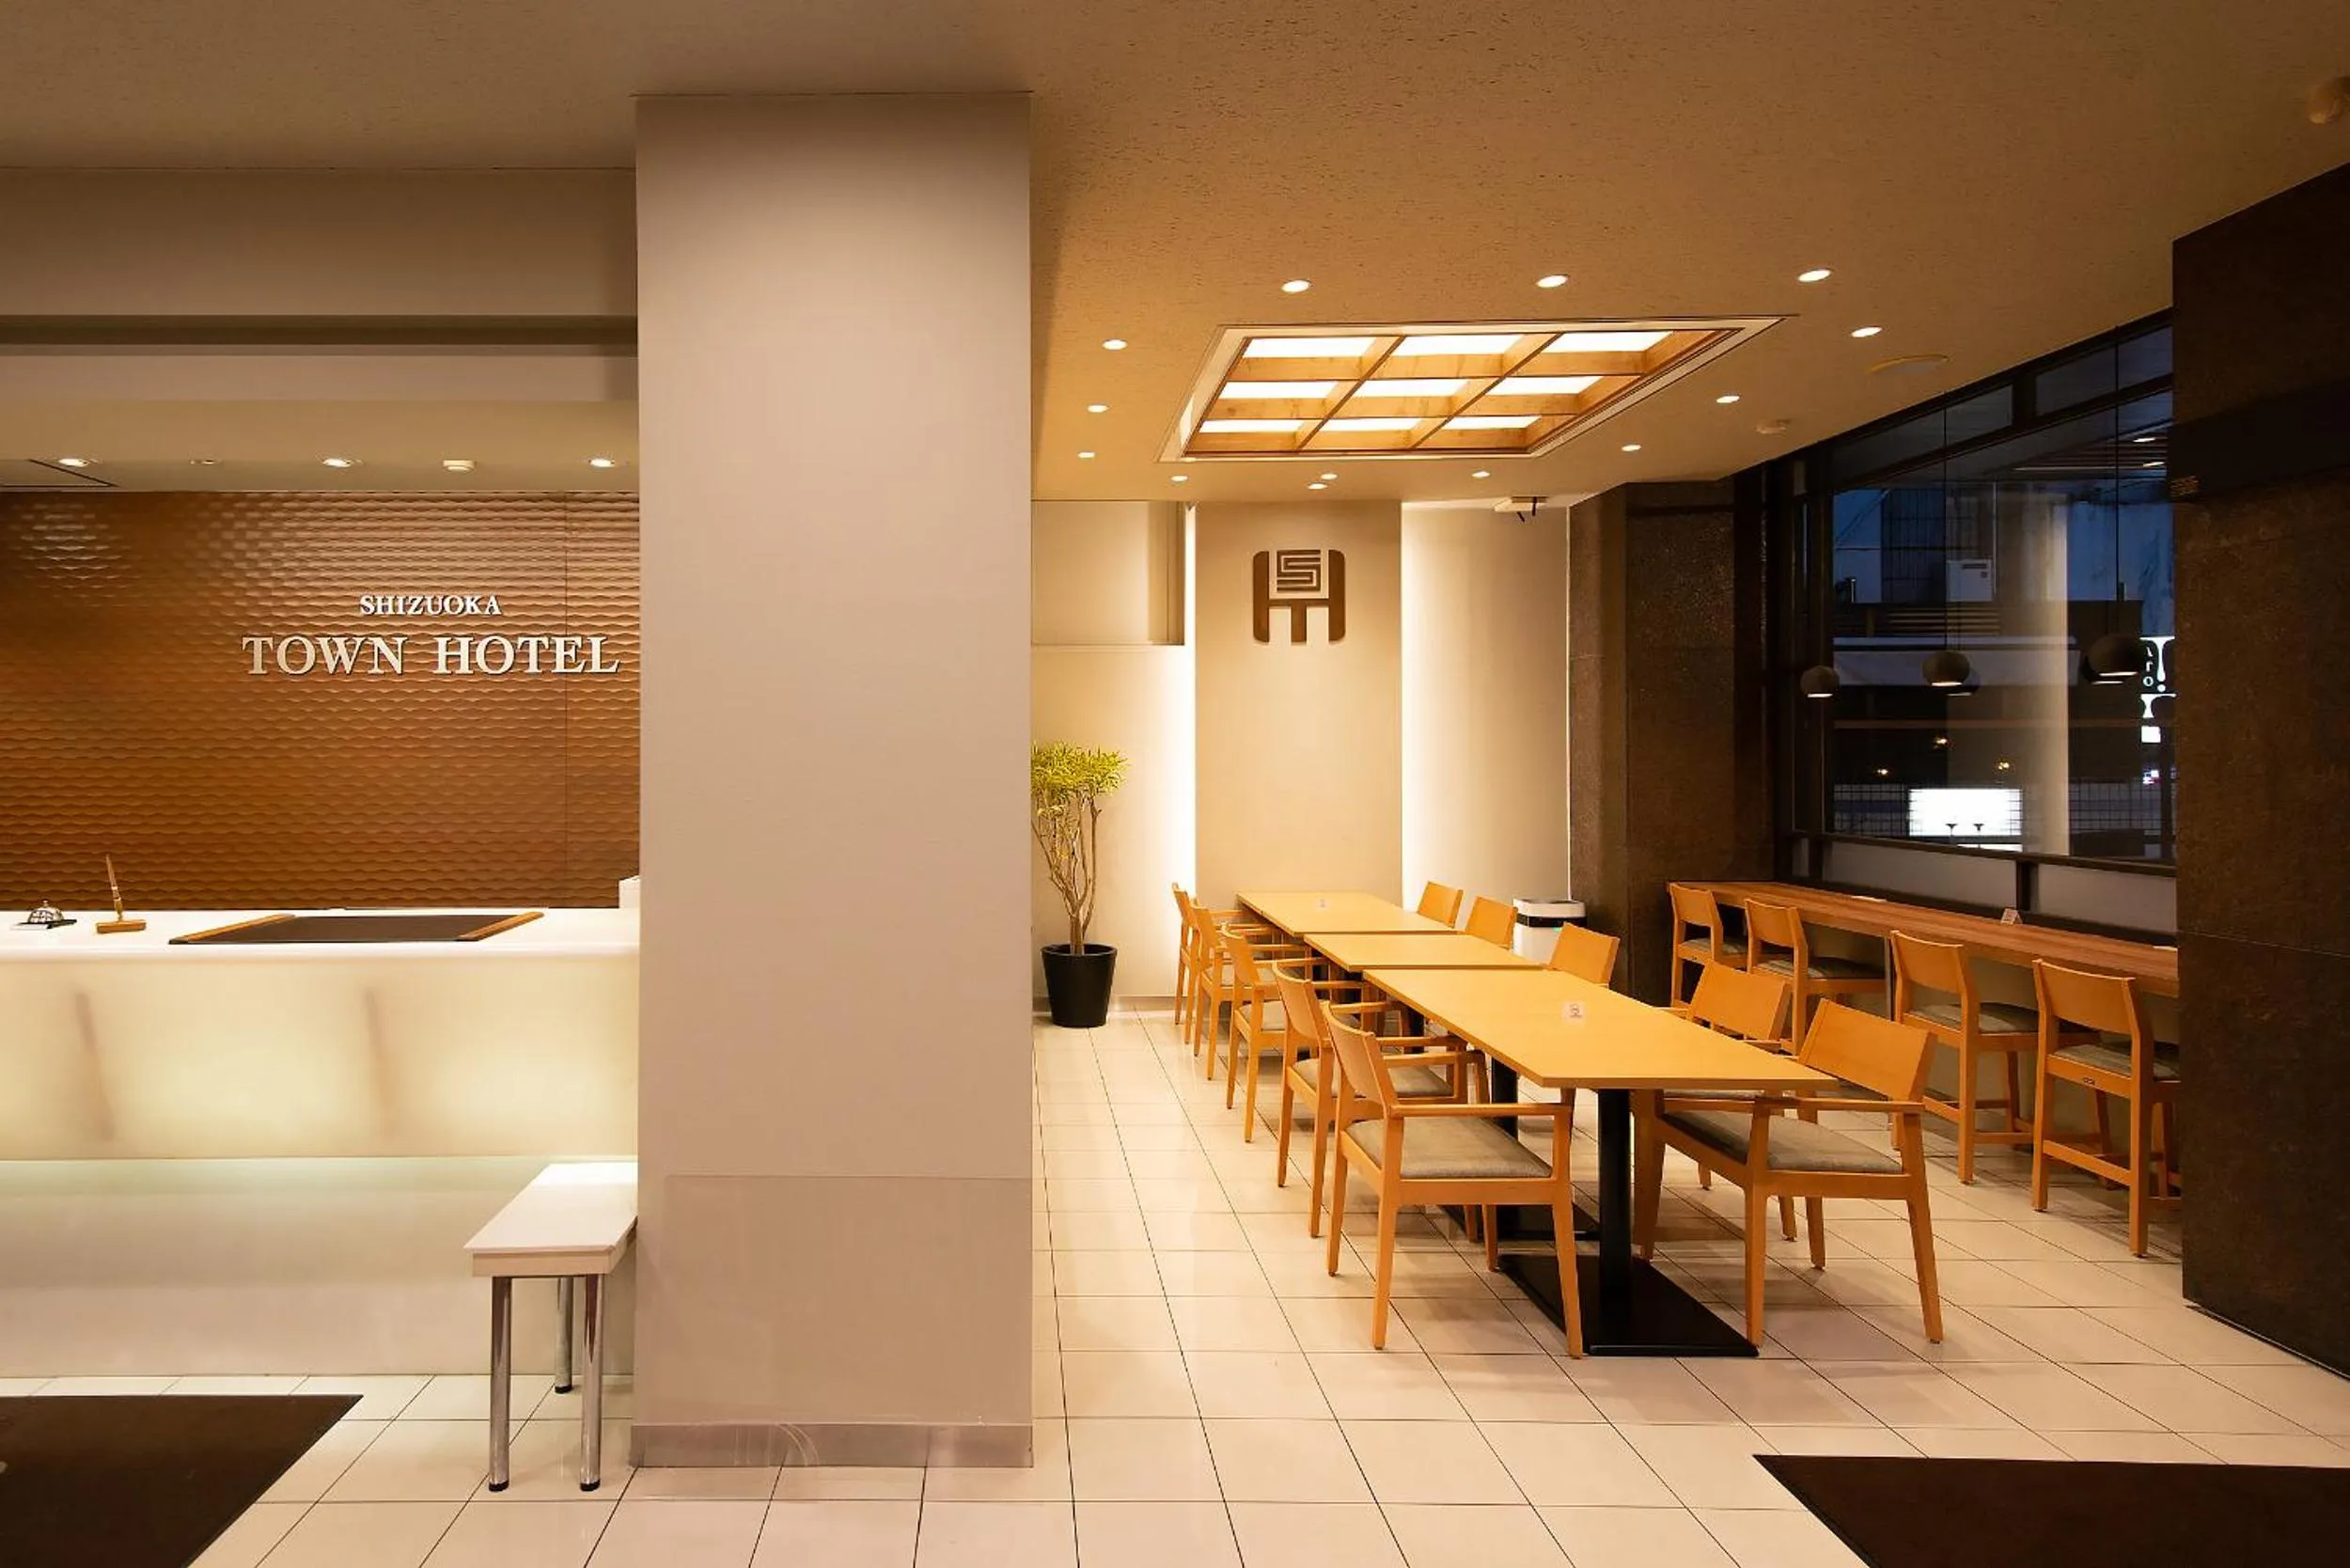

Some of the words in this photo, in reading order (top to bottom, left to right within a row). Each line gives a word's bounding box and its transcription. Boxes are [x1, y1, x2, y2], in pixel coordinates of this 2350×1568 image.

[359, 594, 502, 615] SHIZUOKA
[242, 635, 408, 675] TOWN
[434, 635, 619, 675] HOTEL
